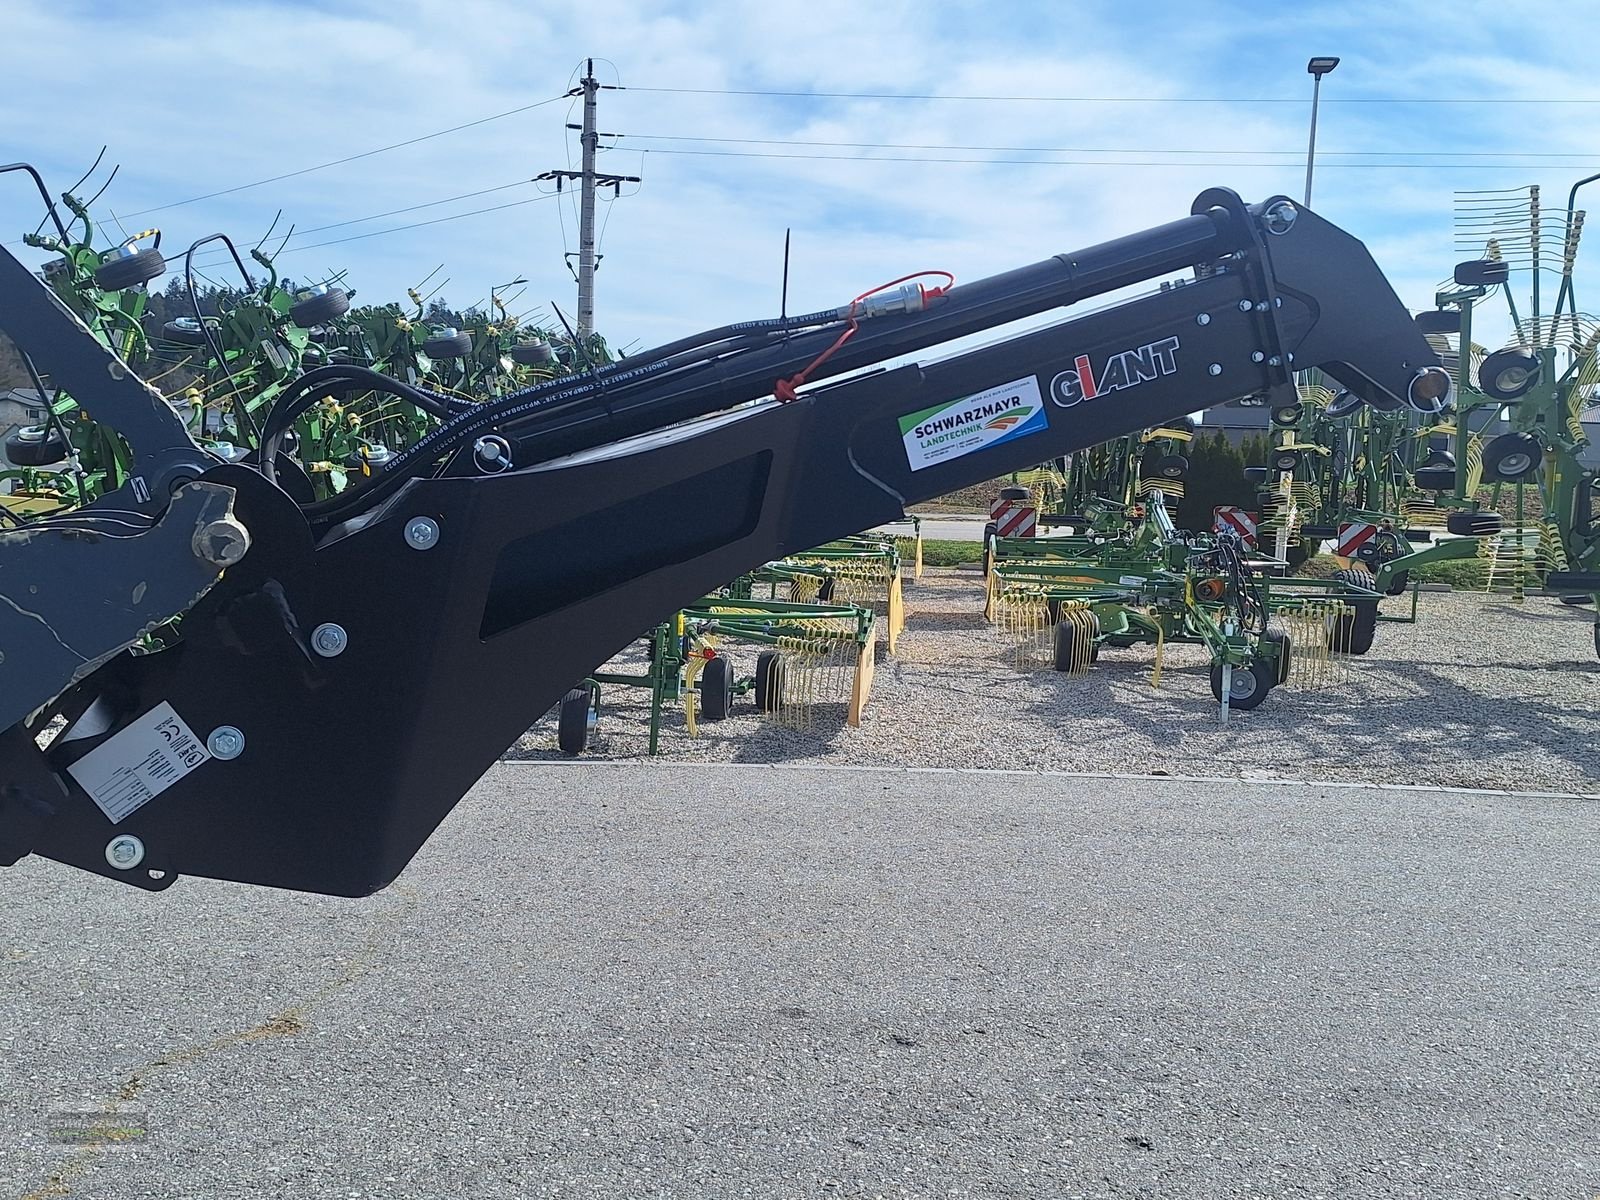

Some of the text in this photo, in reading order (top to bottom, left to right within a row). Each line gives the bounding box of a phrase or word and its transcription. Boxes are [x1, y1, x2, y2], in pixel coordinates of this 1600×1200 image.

[634, 360, 668, 375] SINOFLEX
[505, 384, 541, 400] COMPACT
[559, 384, 594, 399] COMPACT
[501, 400, 540, 417] WP330BAR
[914, 396, 1021, 439] SCHWARZMAYR
[409, 424, 449, 454] BP1320BAR
[920, 424, 983, 449] LANDTECHNIK
[384, 451, 409, 473] 4Q2023
